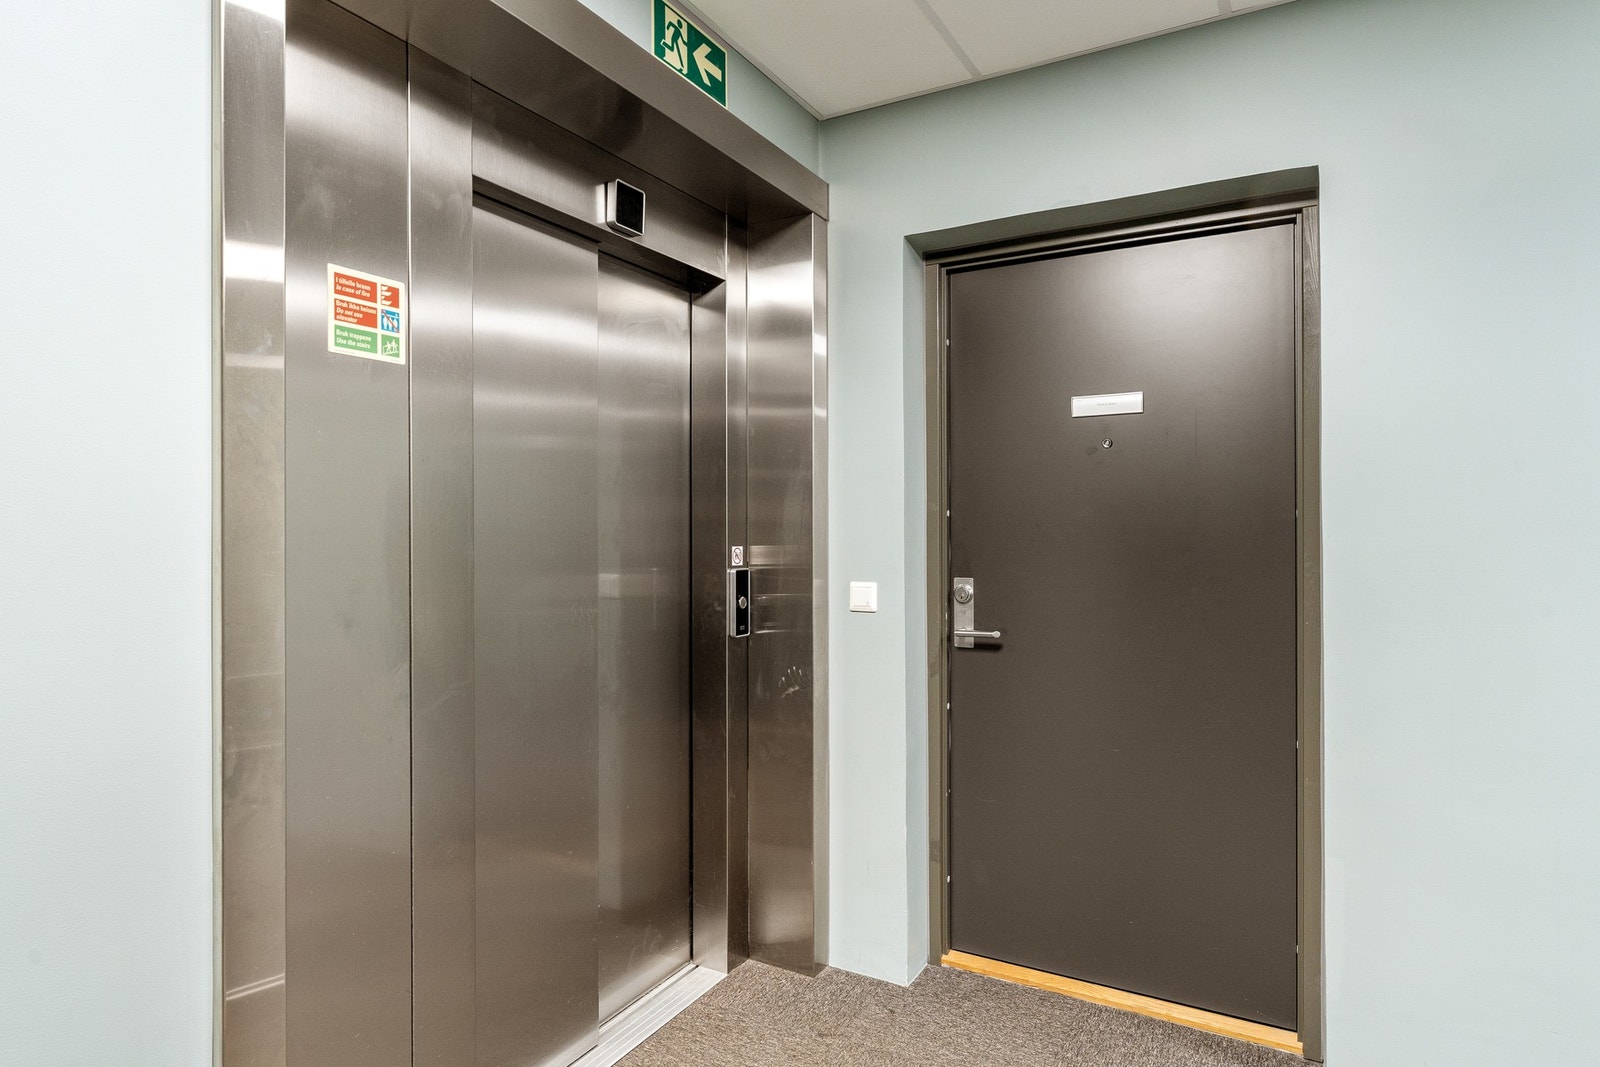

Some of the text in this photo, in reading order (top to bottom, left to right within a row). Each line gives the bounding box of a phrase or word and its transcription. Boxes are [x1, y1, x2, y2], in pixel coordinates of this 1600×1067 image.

[342, 286, 355, 294] case
[336, 306, 345, 314] Do
[336, 336, 347, 345] Use
